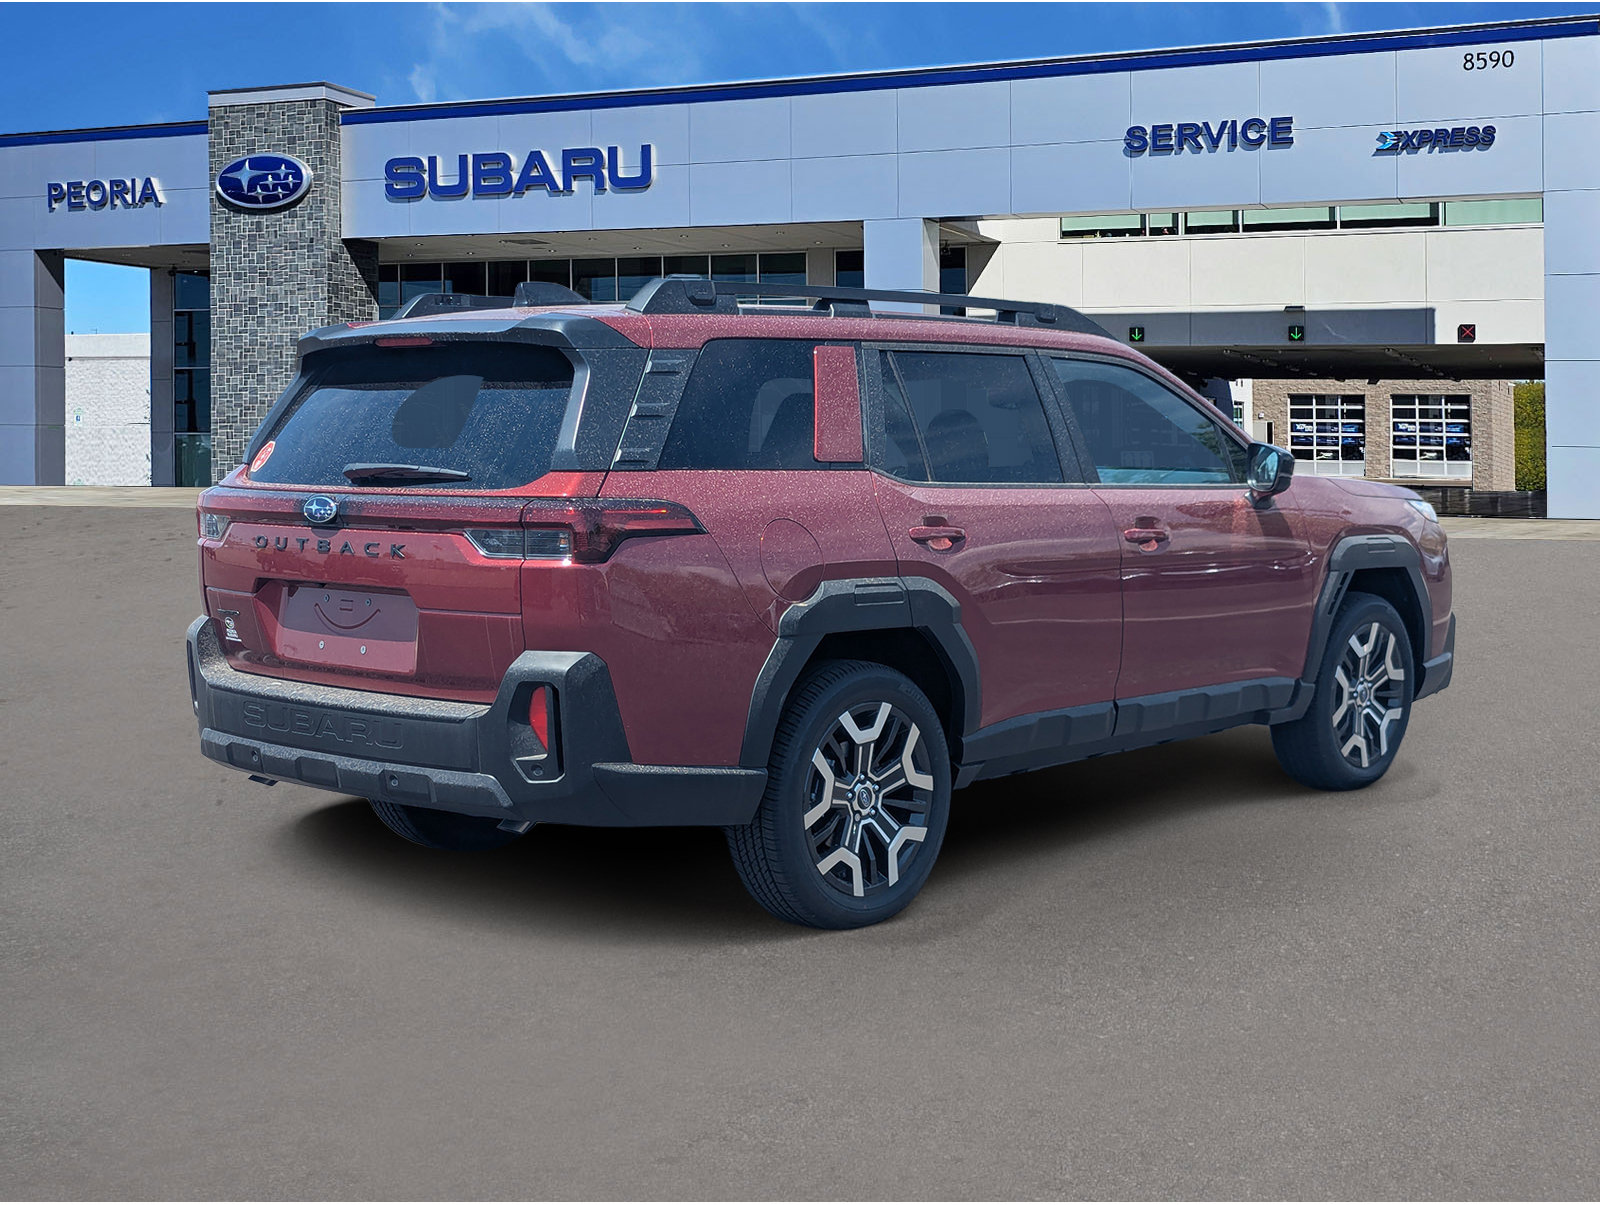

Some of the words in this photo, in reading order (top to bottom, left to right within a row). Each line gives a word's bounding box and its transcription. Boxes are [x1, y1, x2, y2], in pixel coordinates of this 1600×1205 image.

[1462, 50, 1515, 71] 8590
[1124, 116, 1295, 155] SERVICE
[1376, 125, 1497, 152] EXPRESS
[384, 143, 654, 201] SUBARU
[47, 176, 166, 212] PEORIA
[254, 535, 406, 559] OUTBACK
[242, 701, 404, 750] SUBARU
